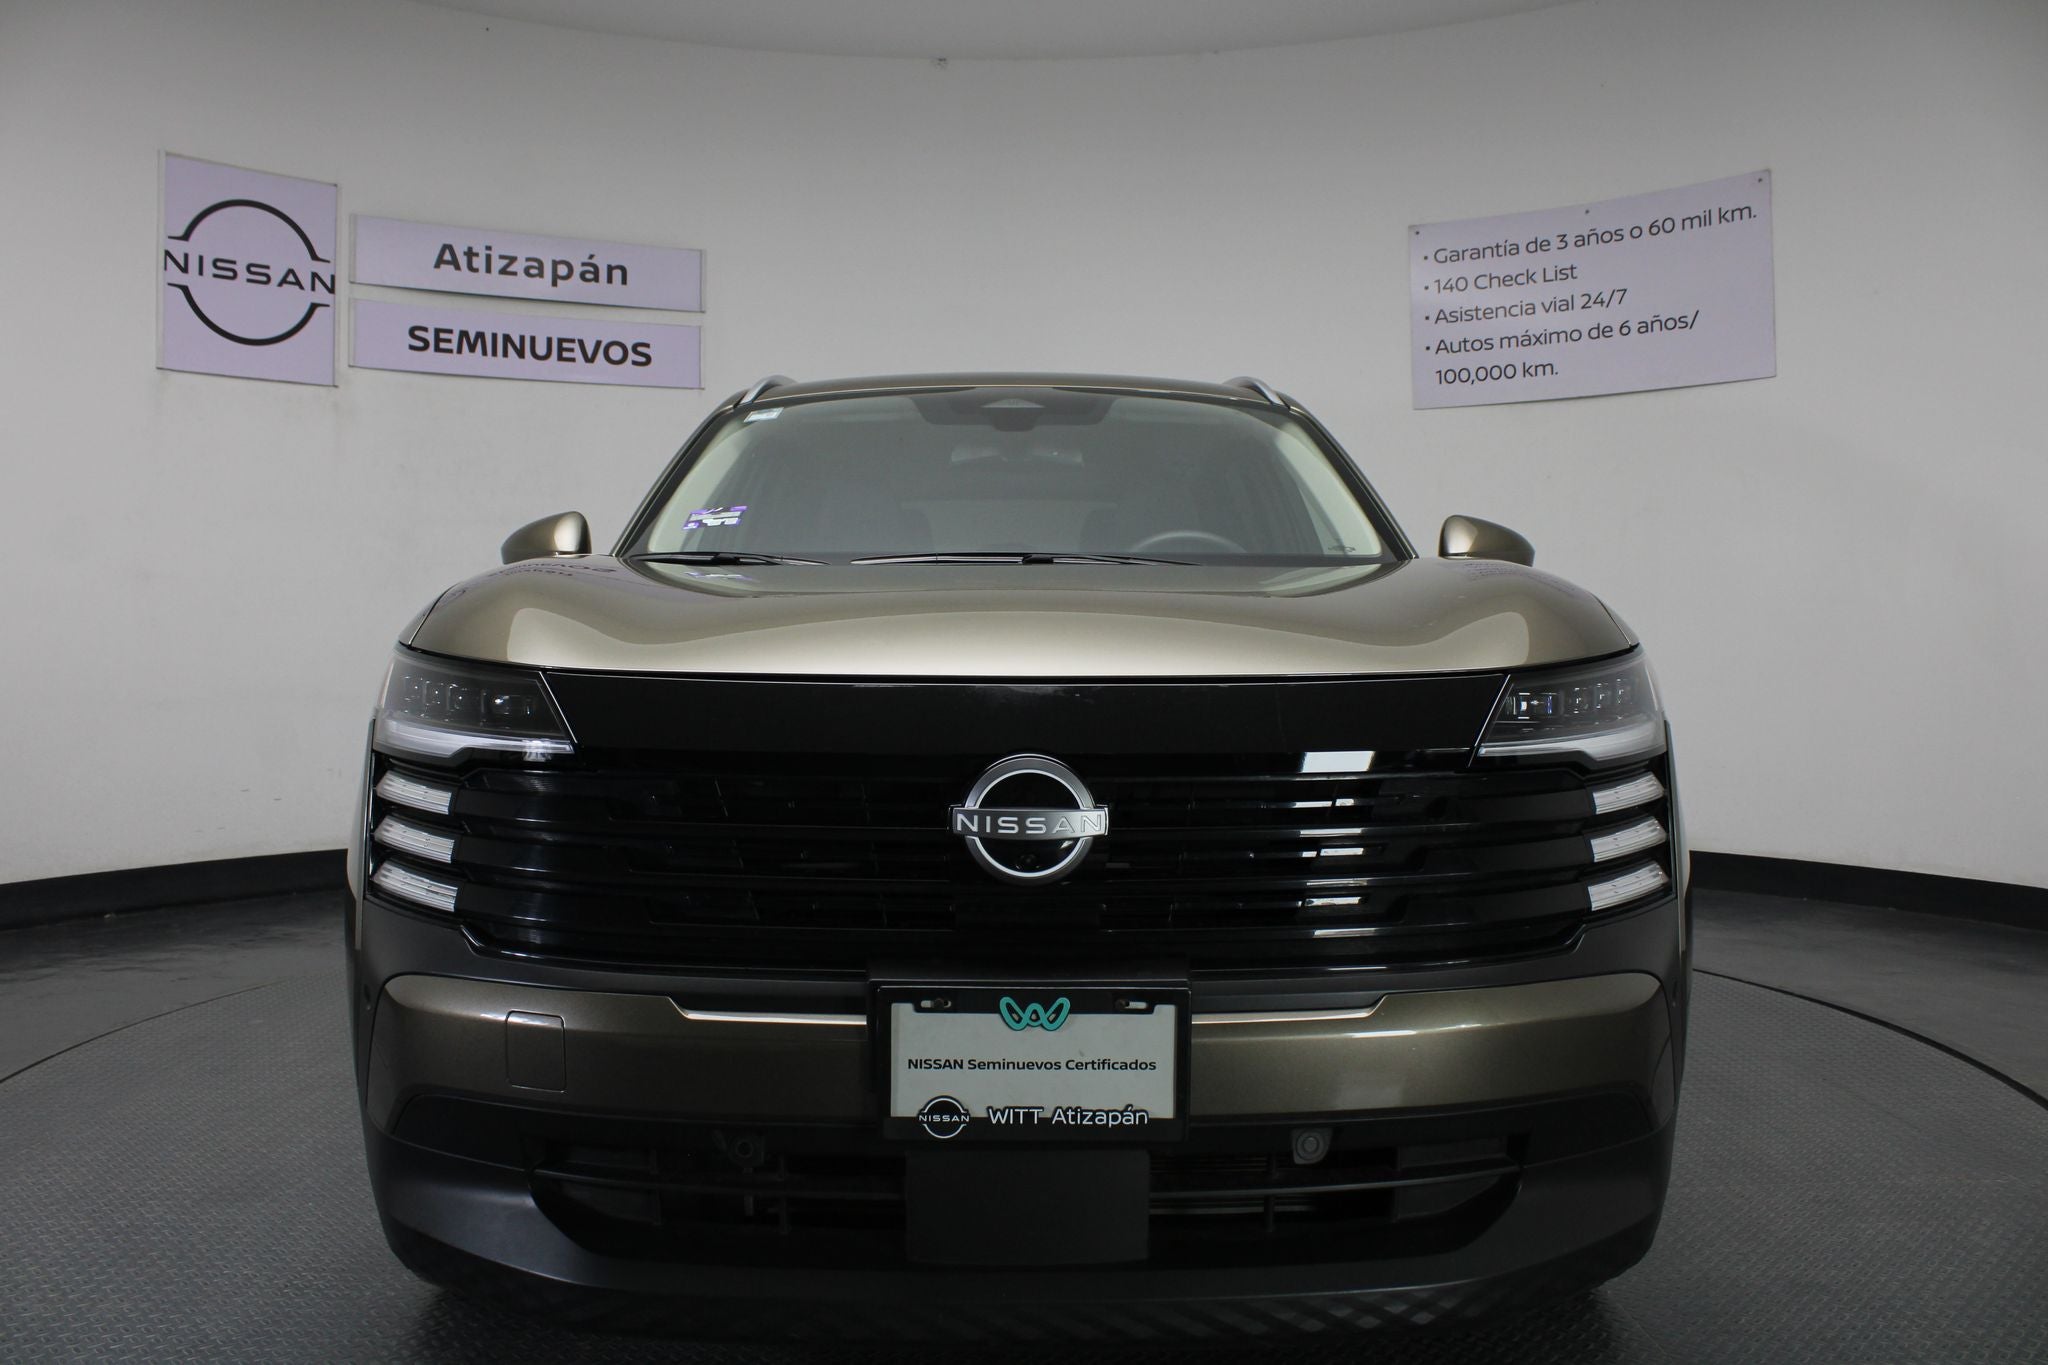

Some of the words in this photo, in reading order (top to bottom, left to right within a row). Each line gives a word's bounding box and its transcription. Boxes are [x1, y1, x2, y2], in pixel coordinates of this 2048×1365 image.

[1434, 240, 1520, 264] Garantía
[1526, 237, 1551, 253] de
[1557, 234, 1568, 250] 3
[1574, 228, 1624, 248] años
[1630, 225, 1643, 239] o
[1648, 217, 1675, 236] 60
[1681, 210, 1712, 231] mil
[1719, 205, 1757, 224] km.
[164, 249, 336, 294] NISSAN
[434, 243, 629, 287] Atizapán
[1434, 277, 1468, 293] 140
[1474, 269, 1537, 290] Check
[1543, 264, 1577, 282] List
[1435, 302, 1536, 324] Asistencia
[1541, 295, 1574, 313] vial
[1581, 288, 1627, 310] 24/7
[408, 325, 652, 367] SEMINUEVOS
[1435, 336, 1494, 354] Autos
[1500, 328, 1582, 349] máximo
[1588, 323, 1613, 339] de
[1619, 321, 1631, 336] 6
[1637, 310, 1699, 334] años/
[1435, 363, 1517, 386] 100,000
[1522, 361, 1558, 377] km.
[956, 813, 1102, 834] NISSAN
[908, 1059, 963, 1070] NISSAN
[968, 1059, 1061, 1071] Seminuevos
[1065, 1059, 1156, 1071] Certificados
[918, 1114, 970, 1122] NISSAN
[988, 1108, 1044, 1125] WITT
[1051, 1105, 1149, 1128] Atizapán
